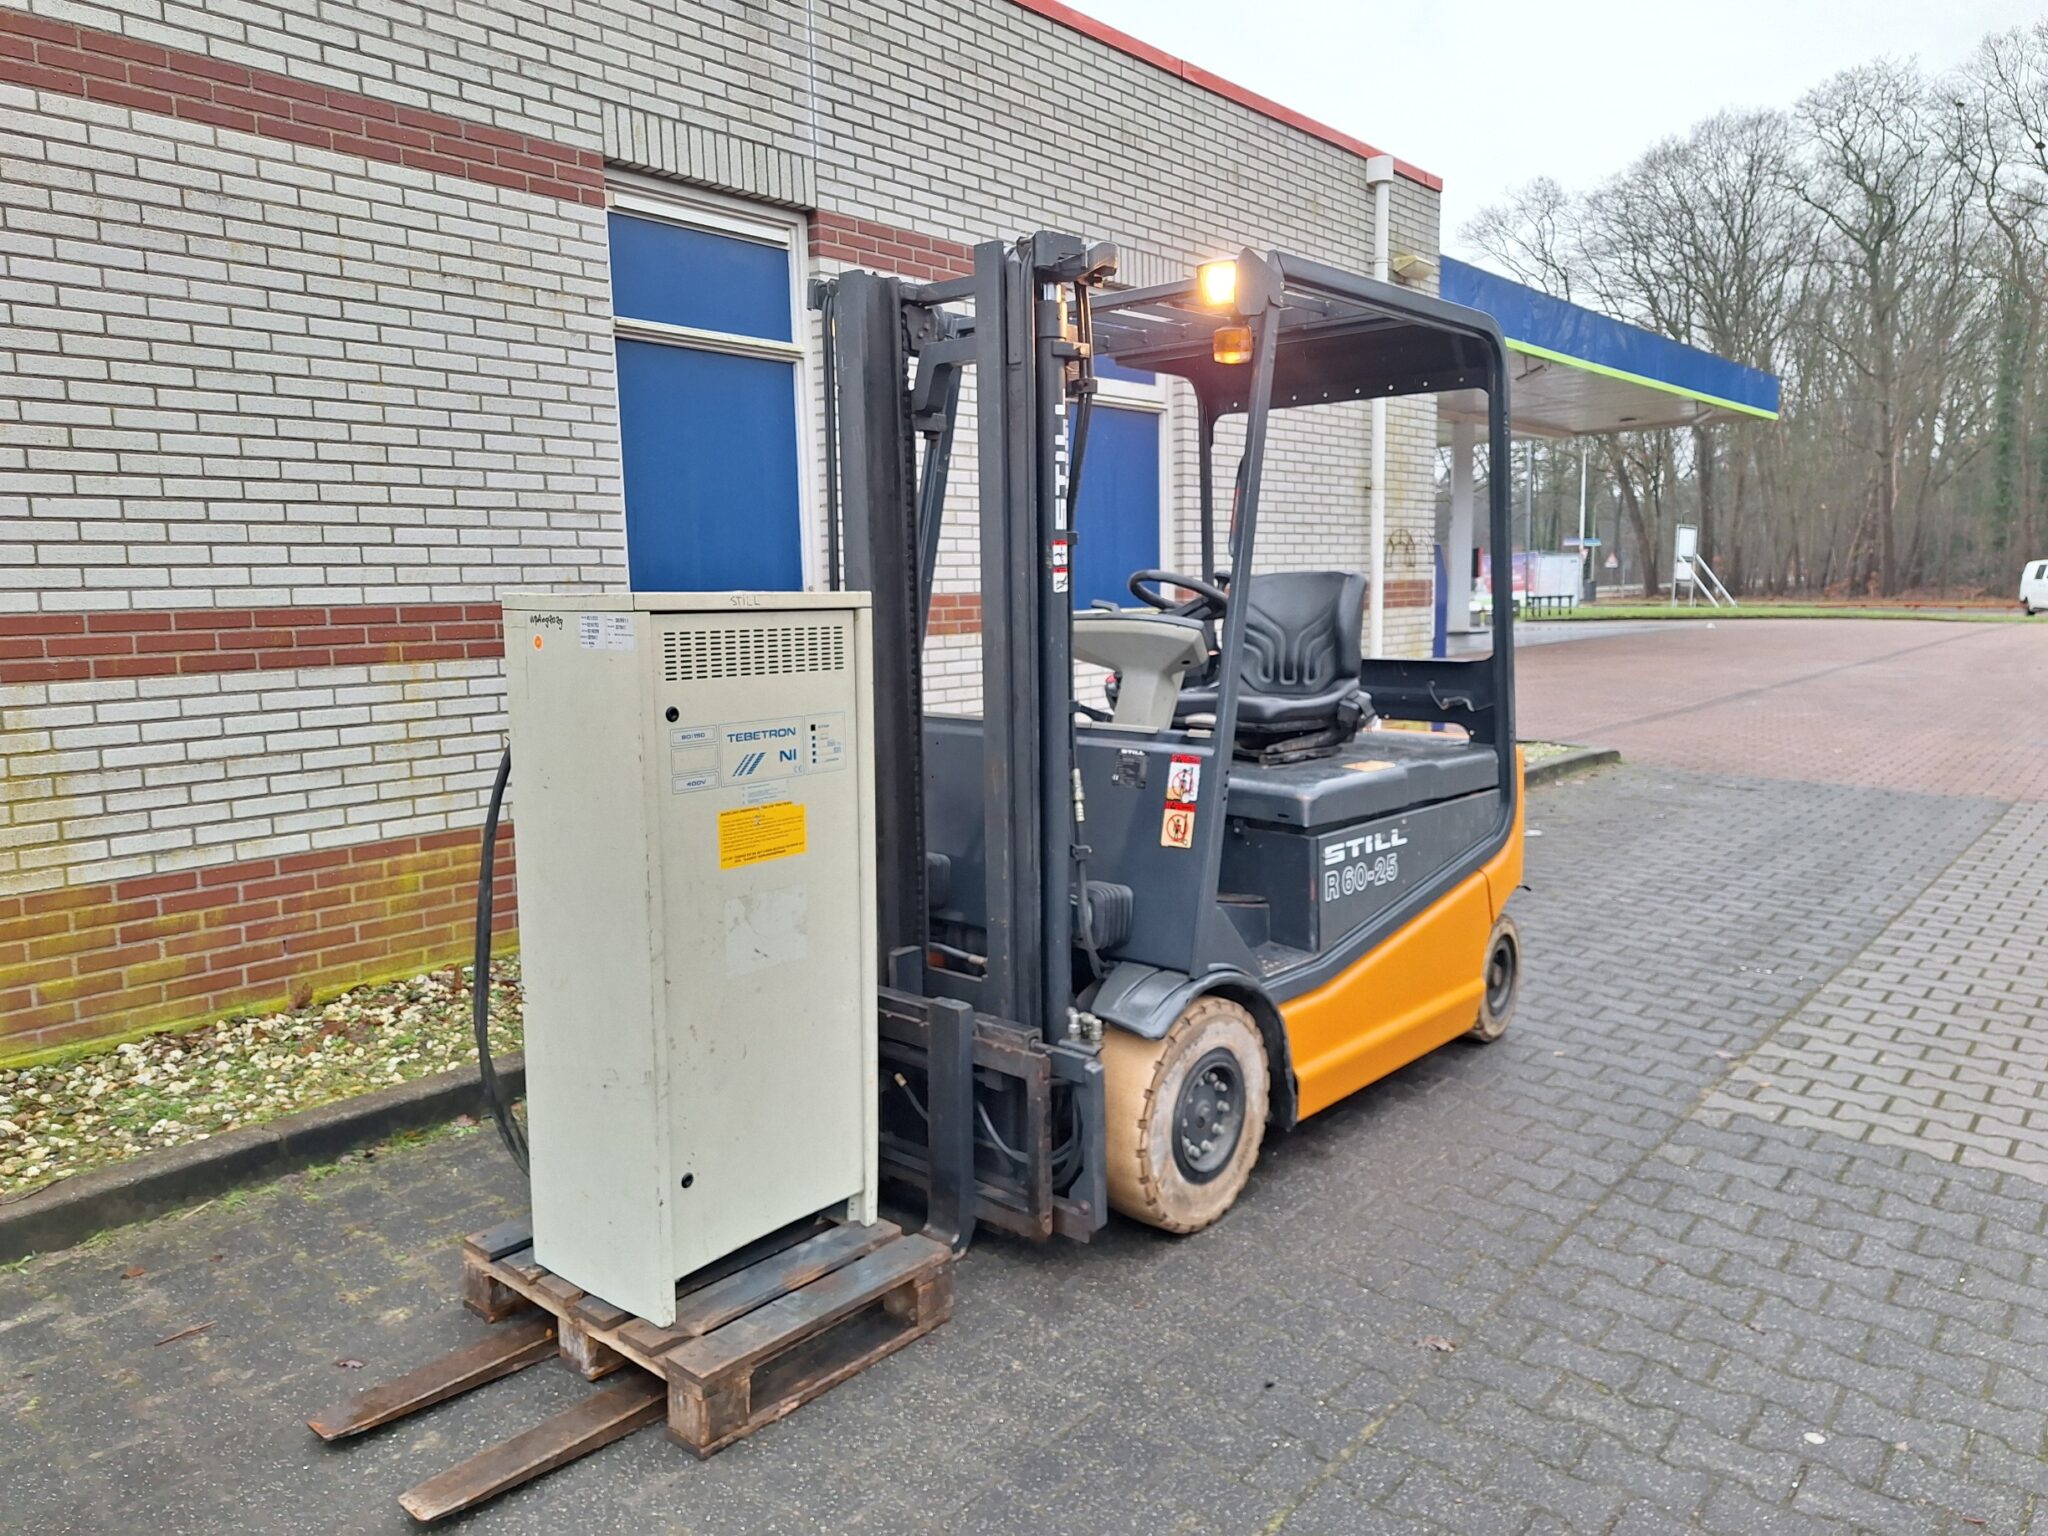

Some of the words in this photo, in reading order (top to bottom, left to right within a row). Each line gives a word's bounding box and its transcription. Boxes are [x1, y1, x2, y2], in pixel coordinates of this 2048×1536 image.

[729, 594, 761, 607] STILL
[727, 727, 797, 743] TEBETRON
[779, 748, 797, 762] NI
[686, 778, 706, 787] 400V
[1324, 828, 1408, 866] STILL
[1324, 869, 1340, 902] R
[1341, 852, 1398, 896] 60-25
